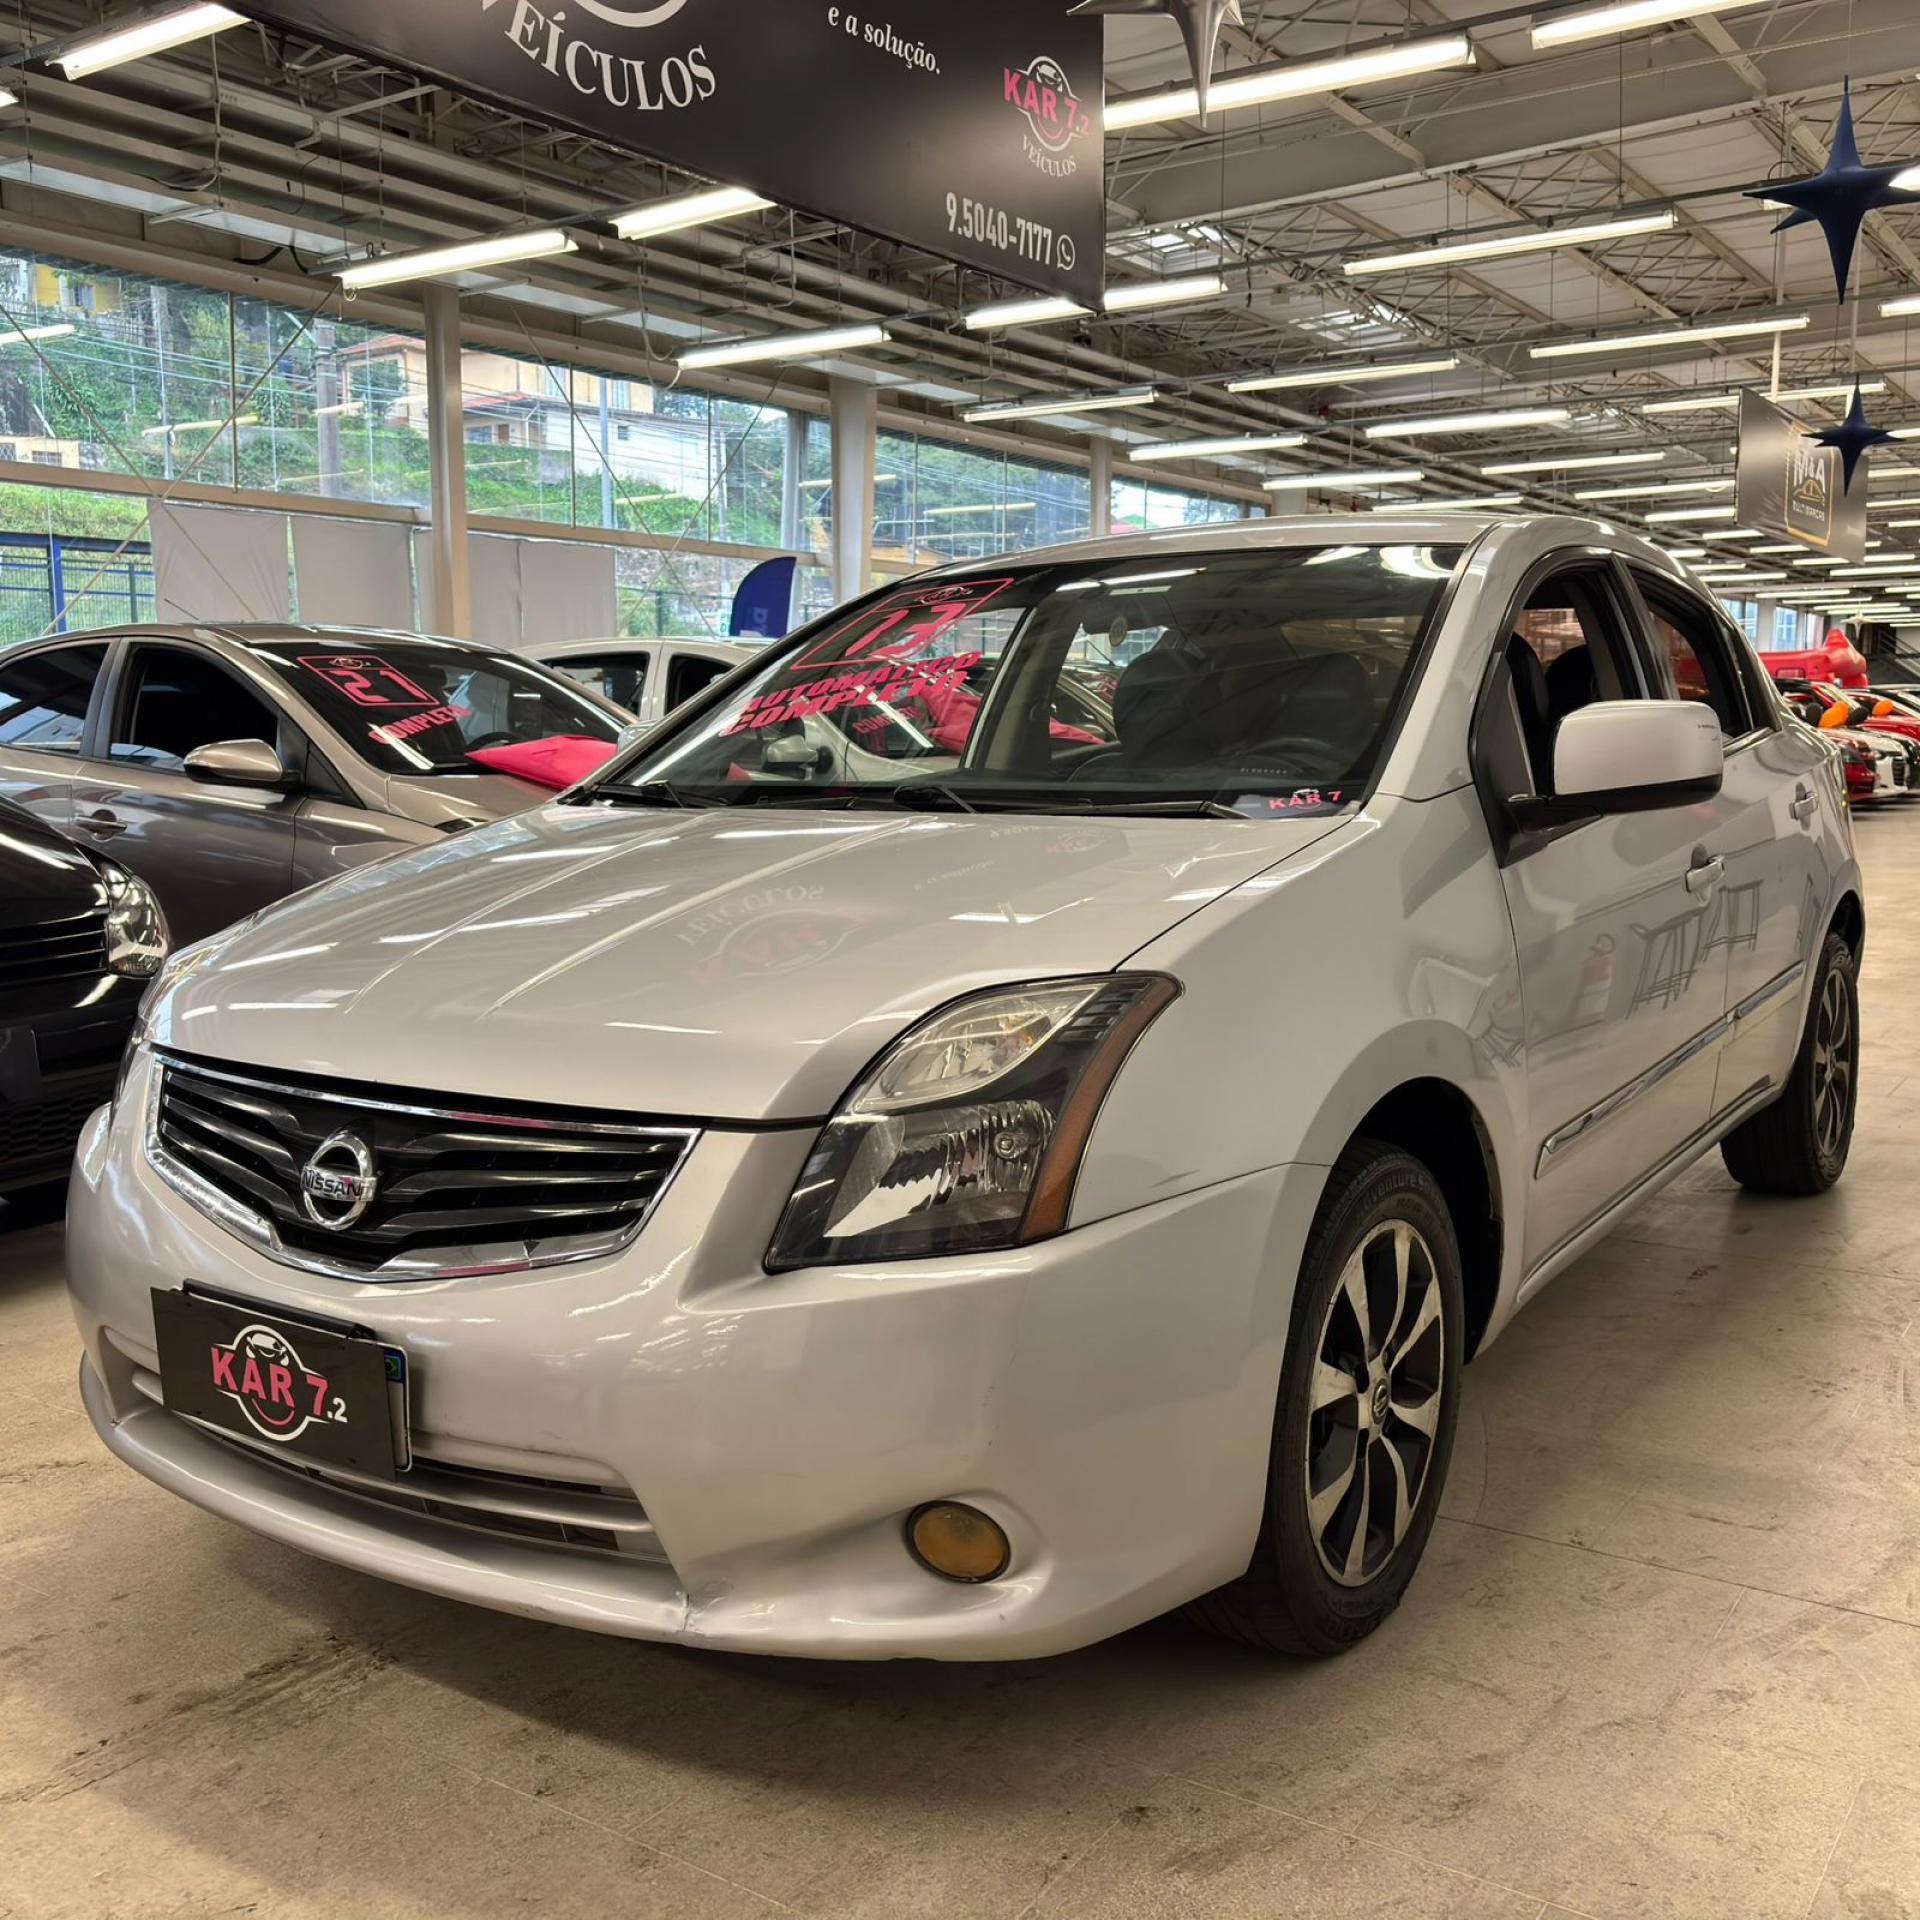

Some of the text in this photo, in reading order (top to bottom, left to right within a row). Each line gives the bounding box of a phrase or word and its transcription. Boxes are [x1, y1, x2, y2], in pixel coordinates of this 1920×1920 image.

[482, 0, 716, 110] EÍCULOS
[827, 6, 941, 75] e a solução.
[1003, 66, 1090, 135] KAR 7.2
[1023, 134, 1077, 177] VEÍCULOS
[946, 191, 1052, 264] 9.5040-7177
[329, 669, 430, 703] 21
[1267, 793, 1323, 810] KAR
[303, 1169, 362, 1196] NISSAN
[210, 1346, 348, 1423] KAR 7.2
